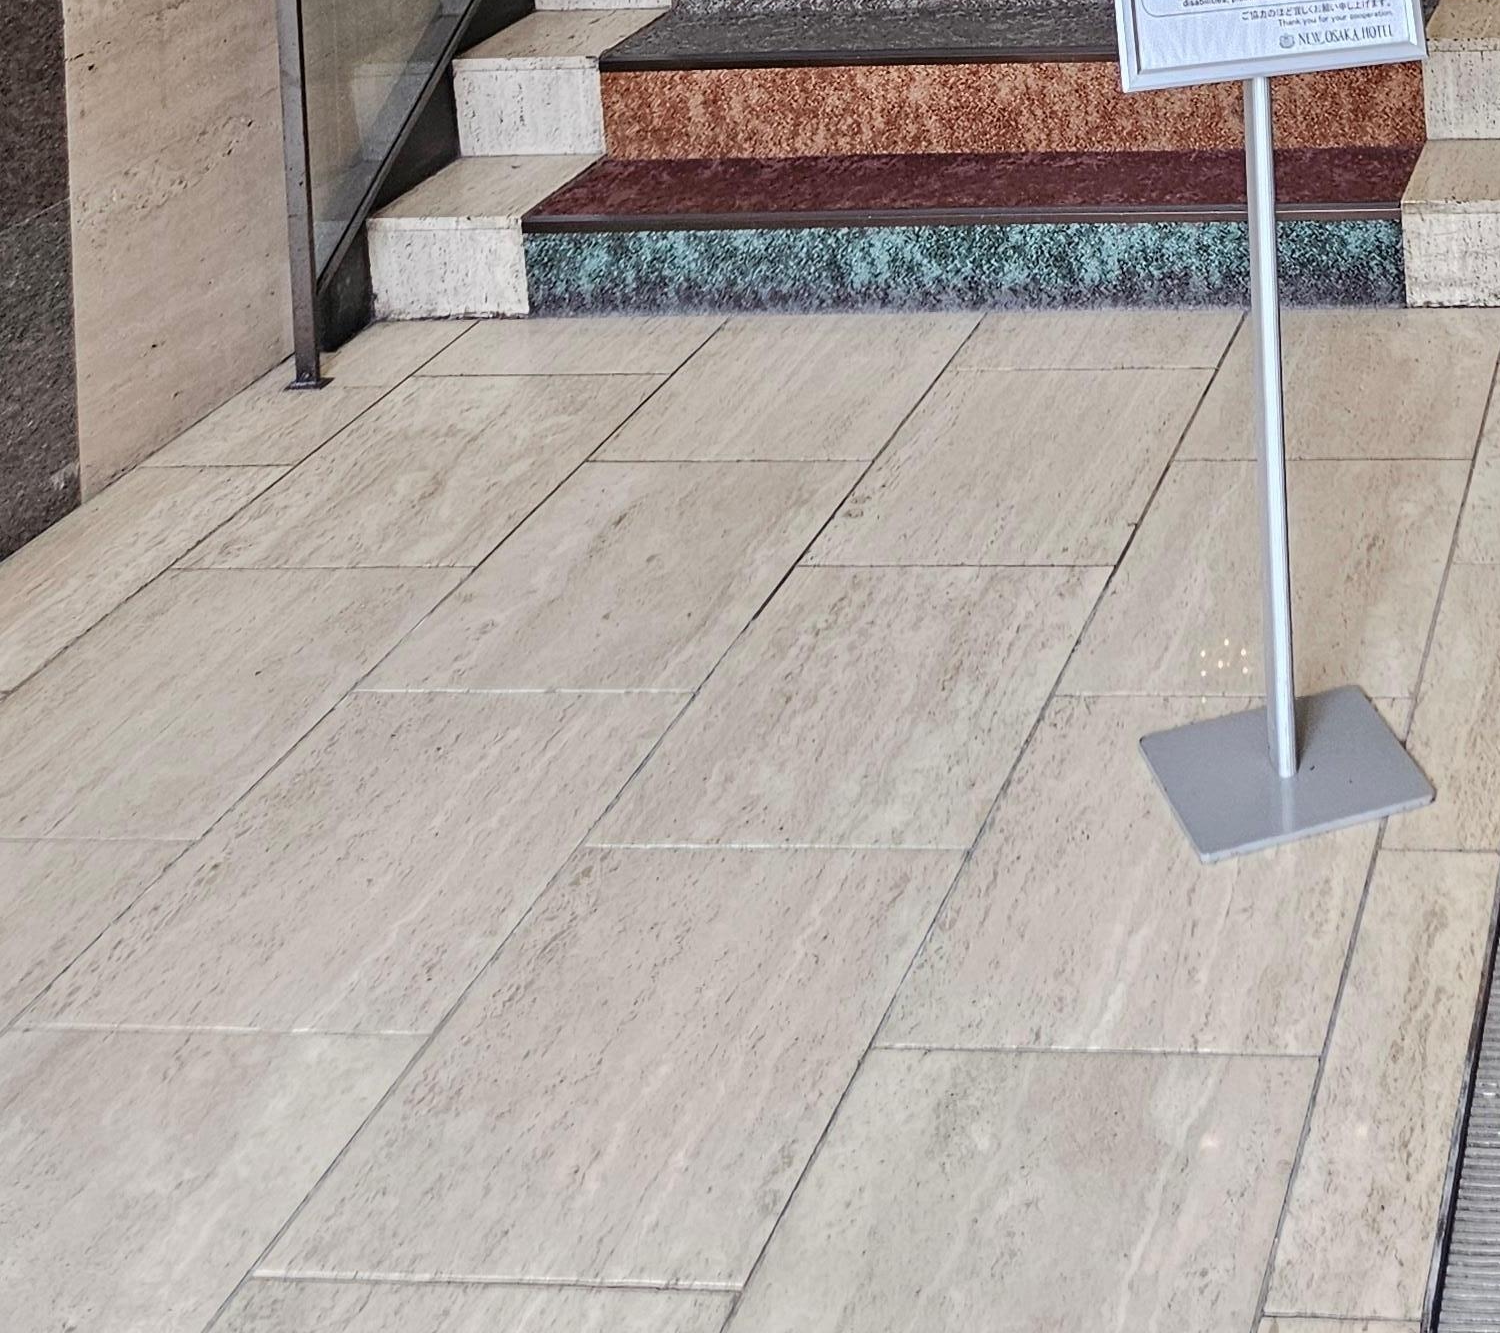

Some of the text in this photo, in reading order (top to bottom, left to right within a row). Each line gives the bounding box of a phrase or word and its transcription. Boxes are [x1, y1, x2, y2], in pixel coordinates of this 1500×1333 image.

[1279, 17, 1301, 27] Thank
[1302, 18, 1317, 26] you
[1325, 28, 1360, 43] OSAKA
[1361, 24, 1394, 40] HOTEL
